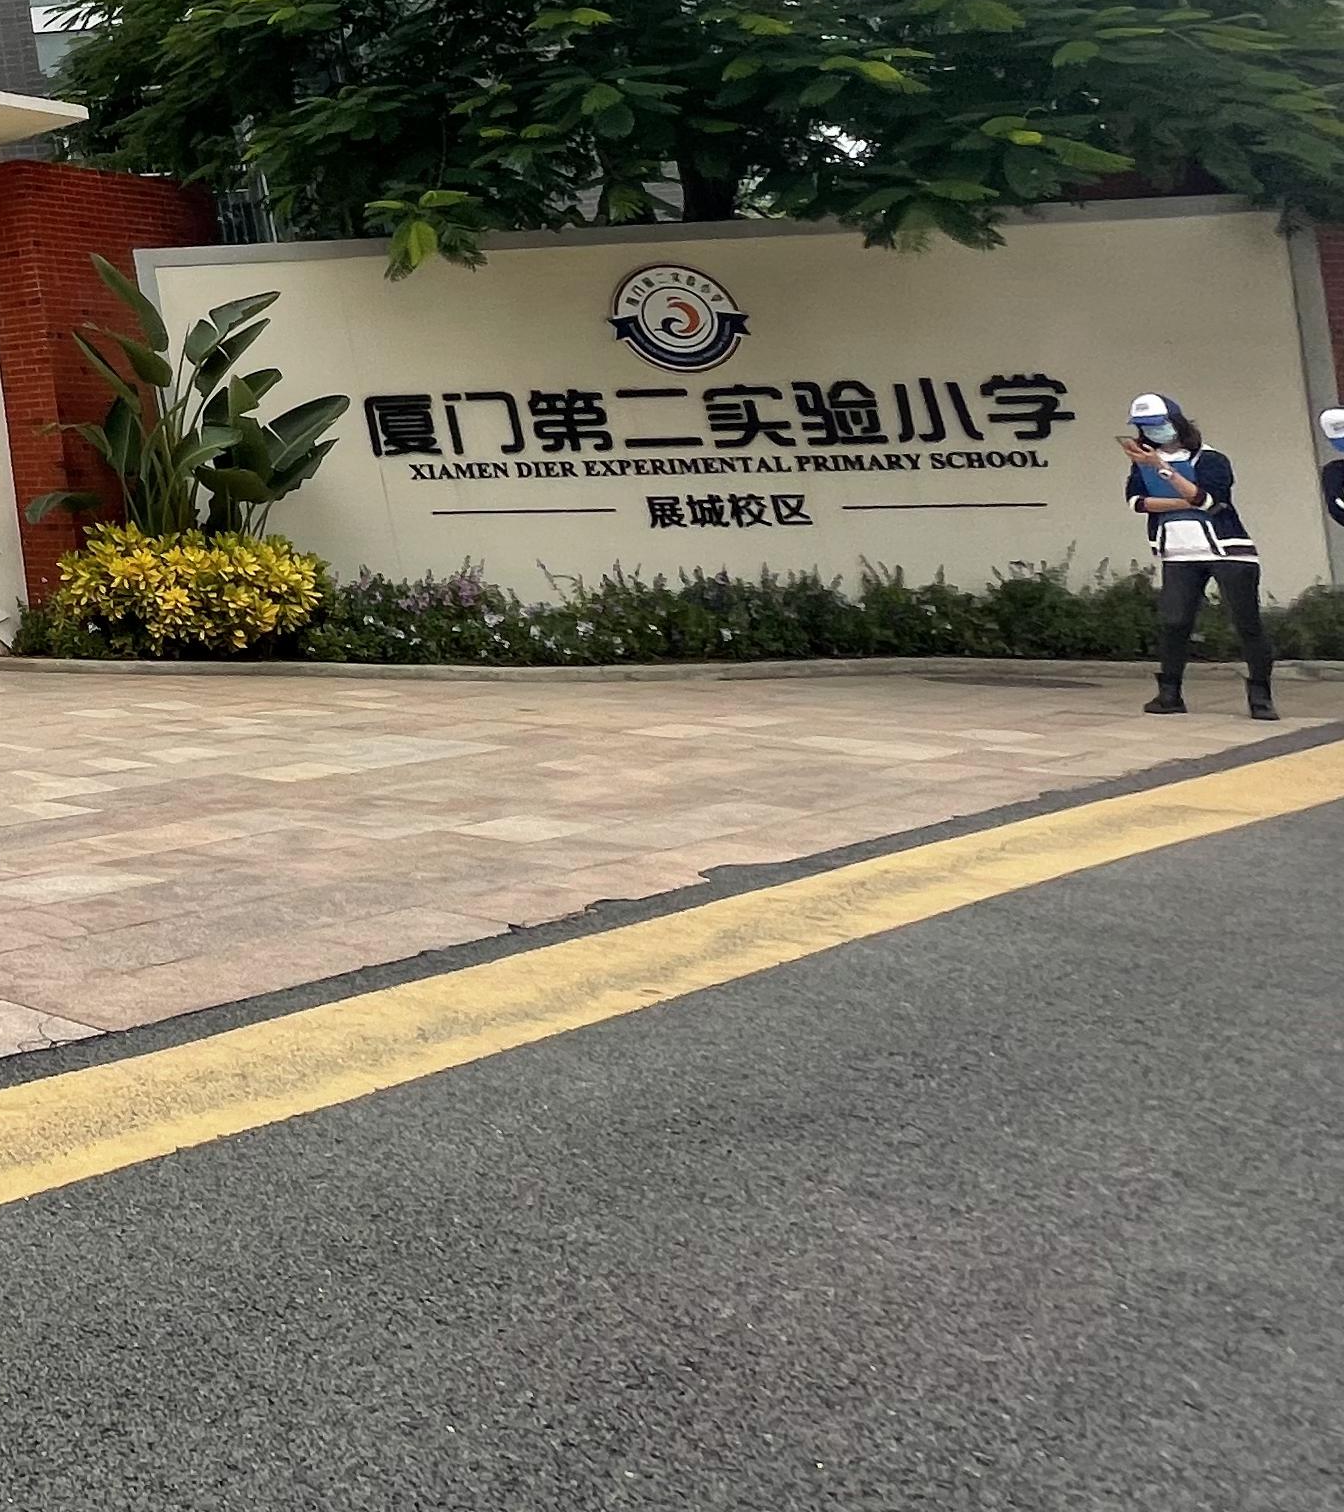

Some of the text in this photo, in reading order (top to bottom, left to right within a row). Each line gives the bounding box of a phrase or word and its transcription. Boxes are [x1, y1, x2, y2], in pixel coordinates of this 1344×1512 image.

[364, 373, 1075, 458] 厦门第二实验小学
[409, 450, 1049, 480] XIAMEN DIER EXPERIMENTAL PRIMARY SCHOOL
[646, 493, 814, 529] 展城校区
